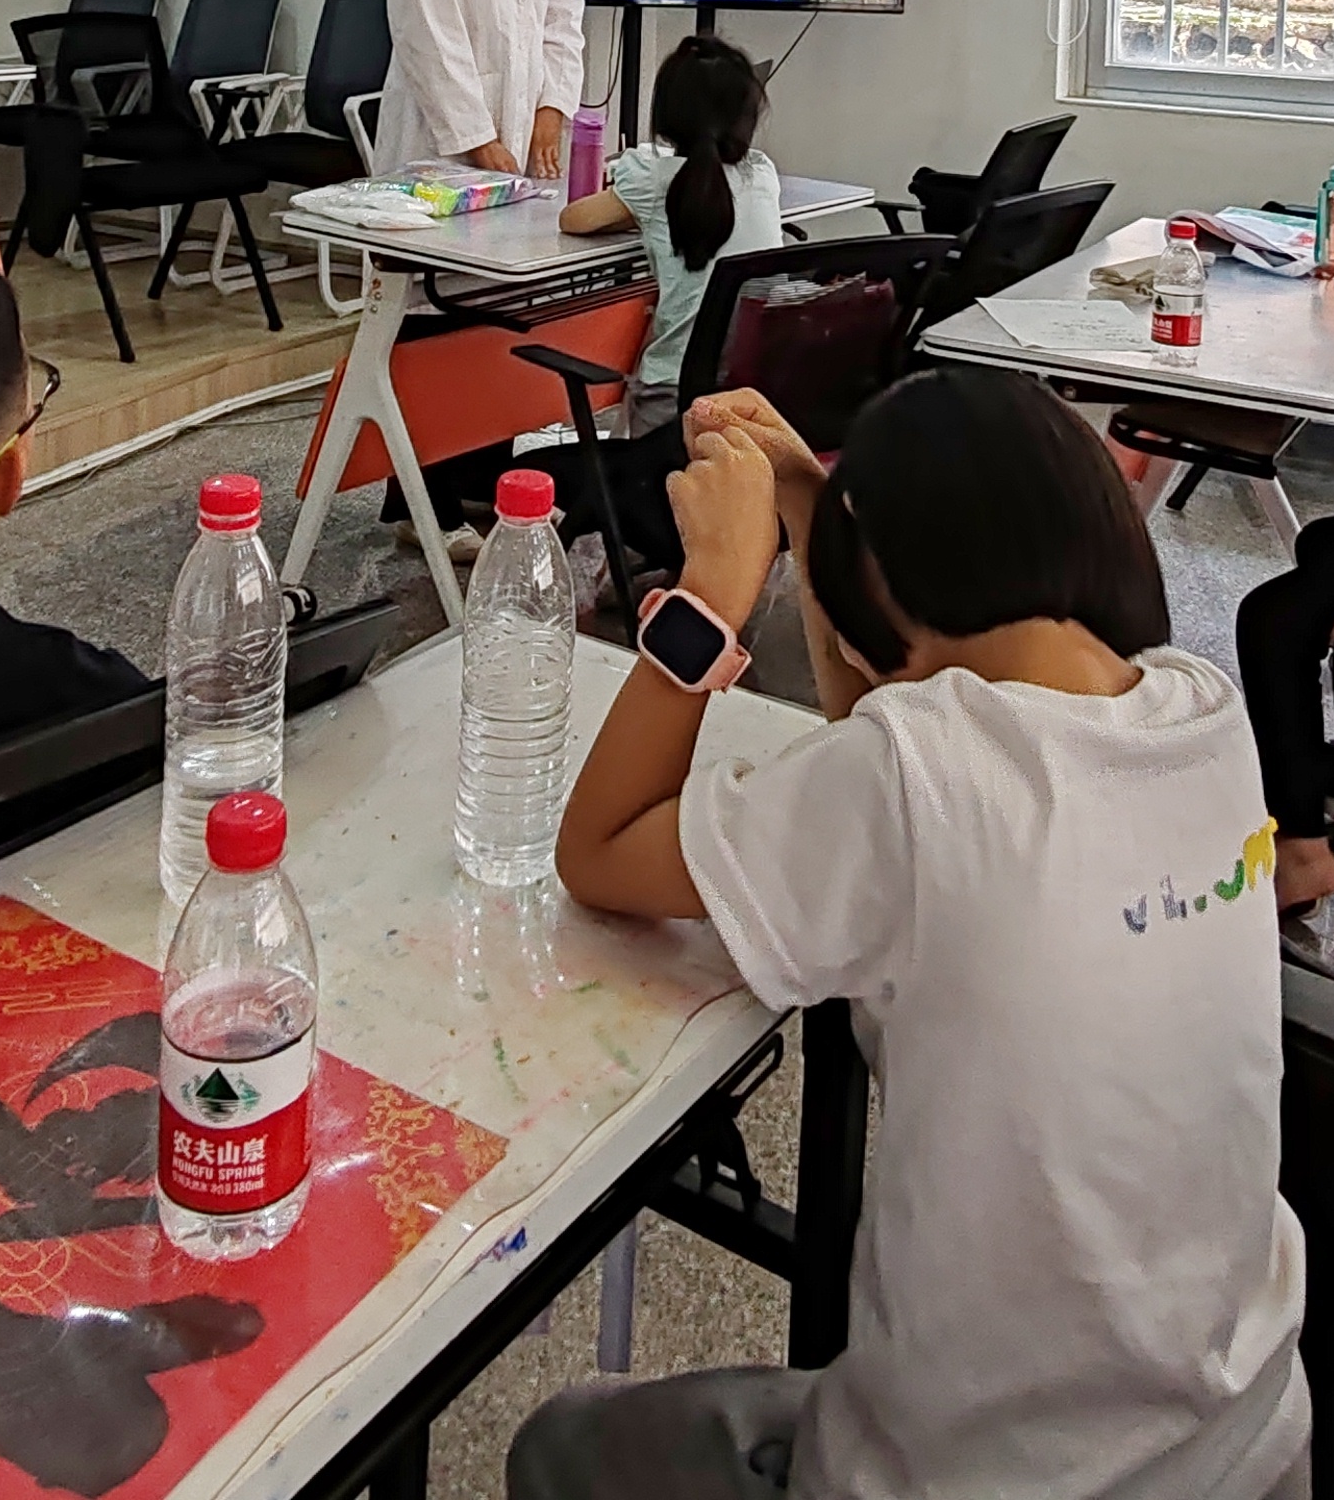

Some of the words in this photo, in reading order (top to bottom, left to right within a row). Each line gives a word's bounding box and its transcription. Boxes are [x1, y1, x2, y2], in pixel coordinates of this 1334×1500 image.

[173, 1130, 267, 1167] 农夫山泉
[172, 1155, 214, 1181] NONGFU
[218, 1163, 266, 1182] SPRING
